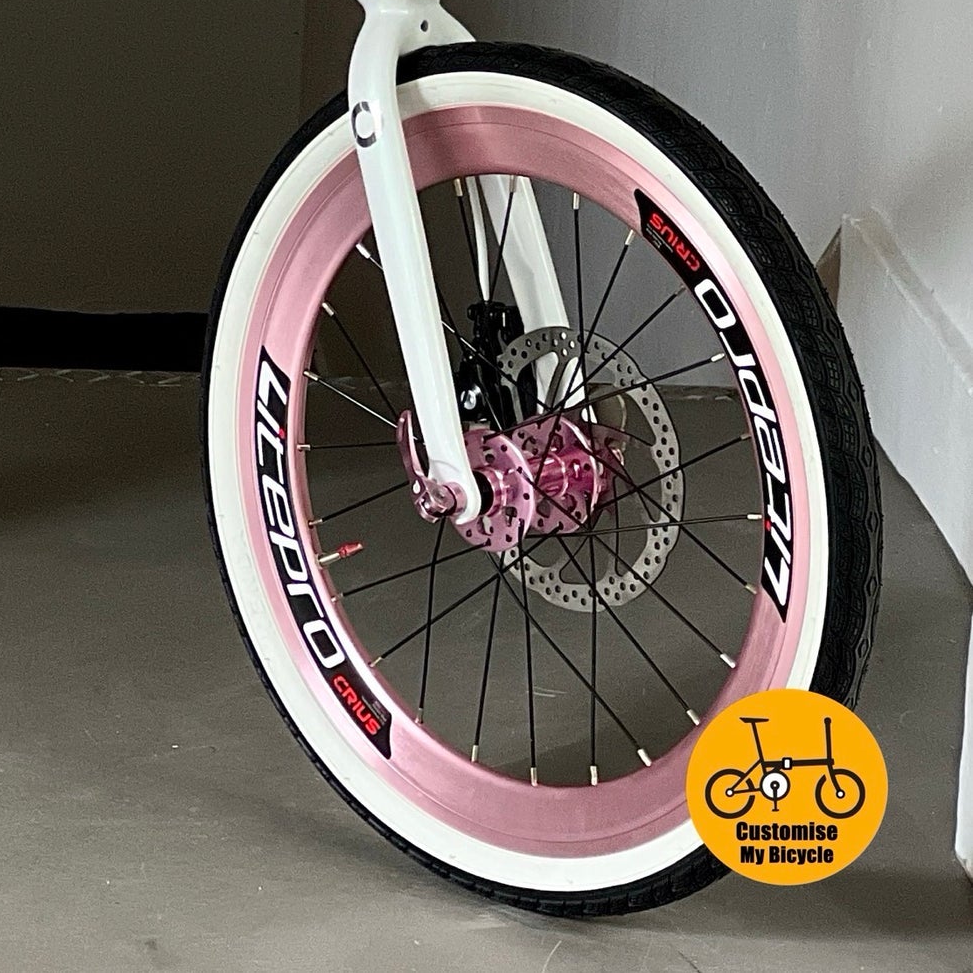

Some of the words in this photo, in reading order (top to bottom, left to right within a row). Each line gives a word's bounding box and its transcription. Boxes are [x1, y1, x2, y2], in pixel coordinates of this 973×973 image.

[649, 212, 701, 272] CRIUS
[257, 360, 345, 669] Litepro
[694, 278, 793, 607] Litepro
[332, 674, 382, 736] CRIUS
